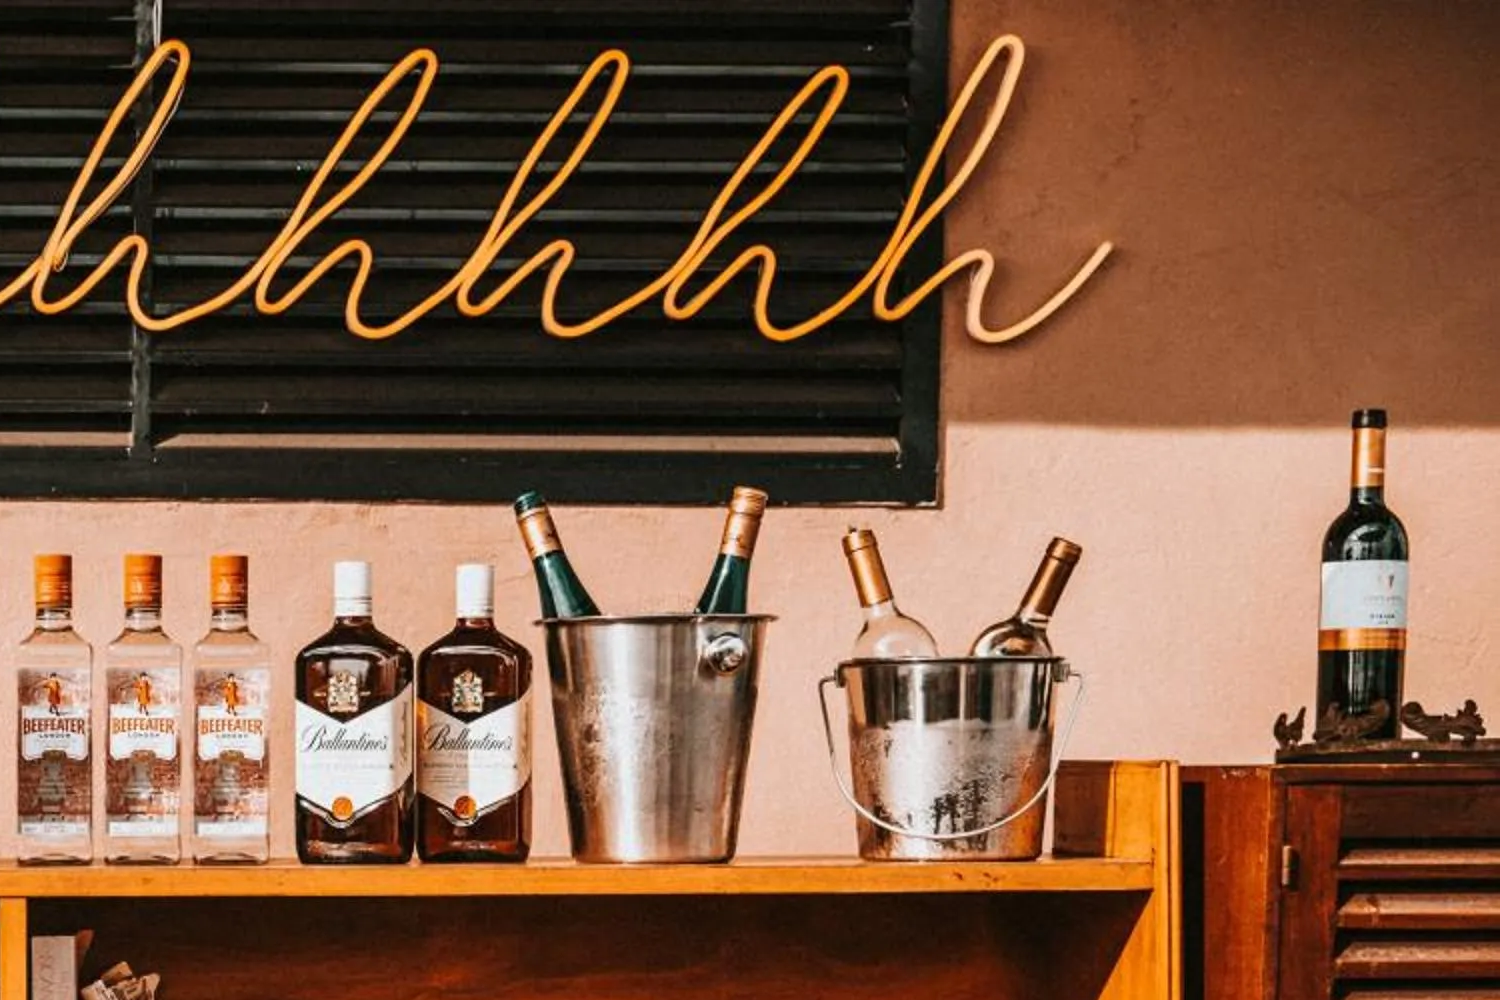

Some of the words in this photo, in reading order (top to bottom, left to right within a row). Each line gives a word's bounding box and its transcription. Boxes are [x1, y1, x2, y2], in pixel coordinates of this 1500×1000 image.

[23, 717, 85, 735] BEEFEATER
[112, 717, 176, 735] BEEFEATER
[199, 717, 264, 735] BEEFEATER
[301, 724, 389, 751] Ballantine's
[424, 724, 513, 751] Ballantine's
